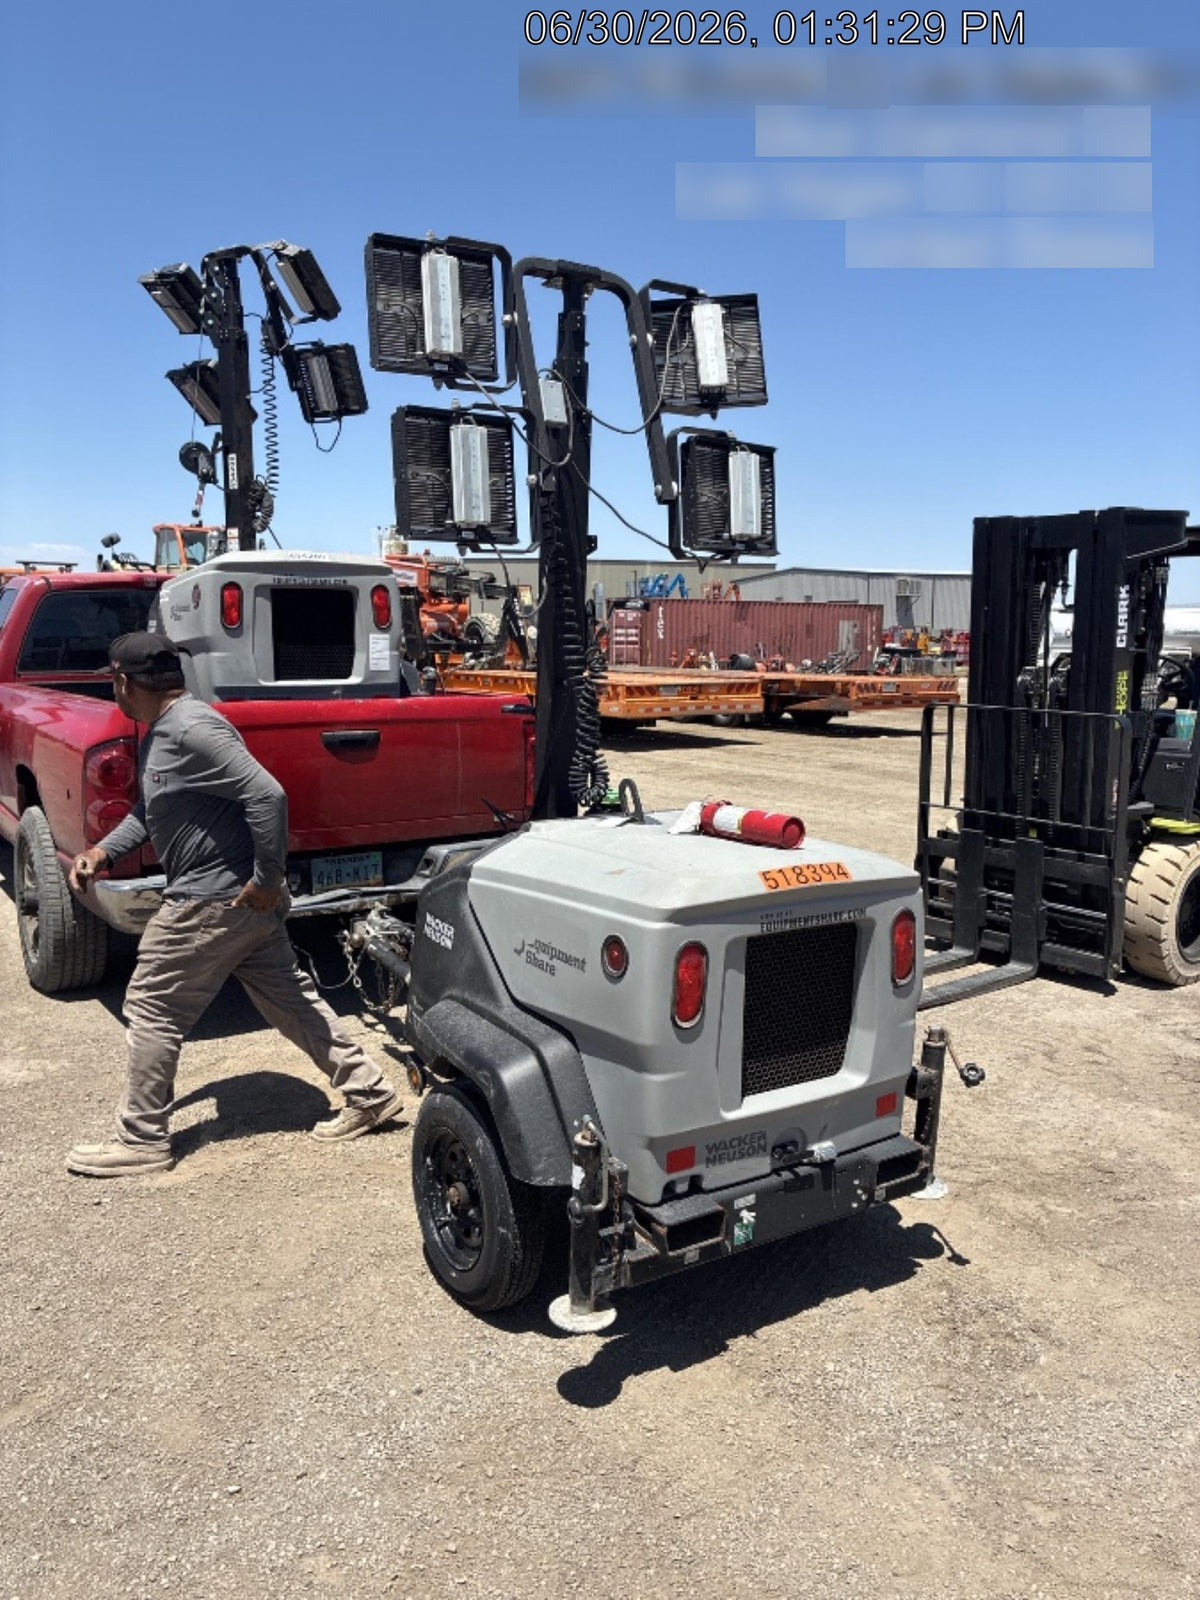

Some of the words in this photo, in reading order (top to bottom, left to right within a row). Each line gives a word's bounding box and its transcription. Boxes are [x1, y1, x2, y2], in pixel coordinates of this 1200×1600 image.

[1116, 584, 1130, 648] CLARK
[762, 863, 849, 890] 518394
[526, 949, 556, 977] Share
[705, 1130, 767, 1155] WACKER
[705, 1141, 767, 1169] NEUSON
